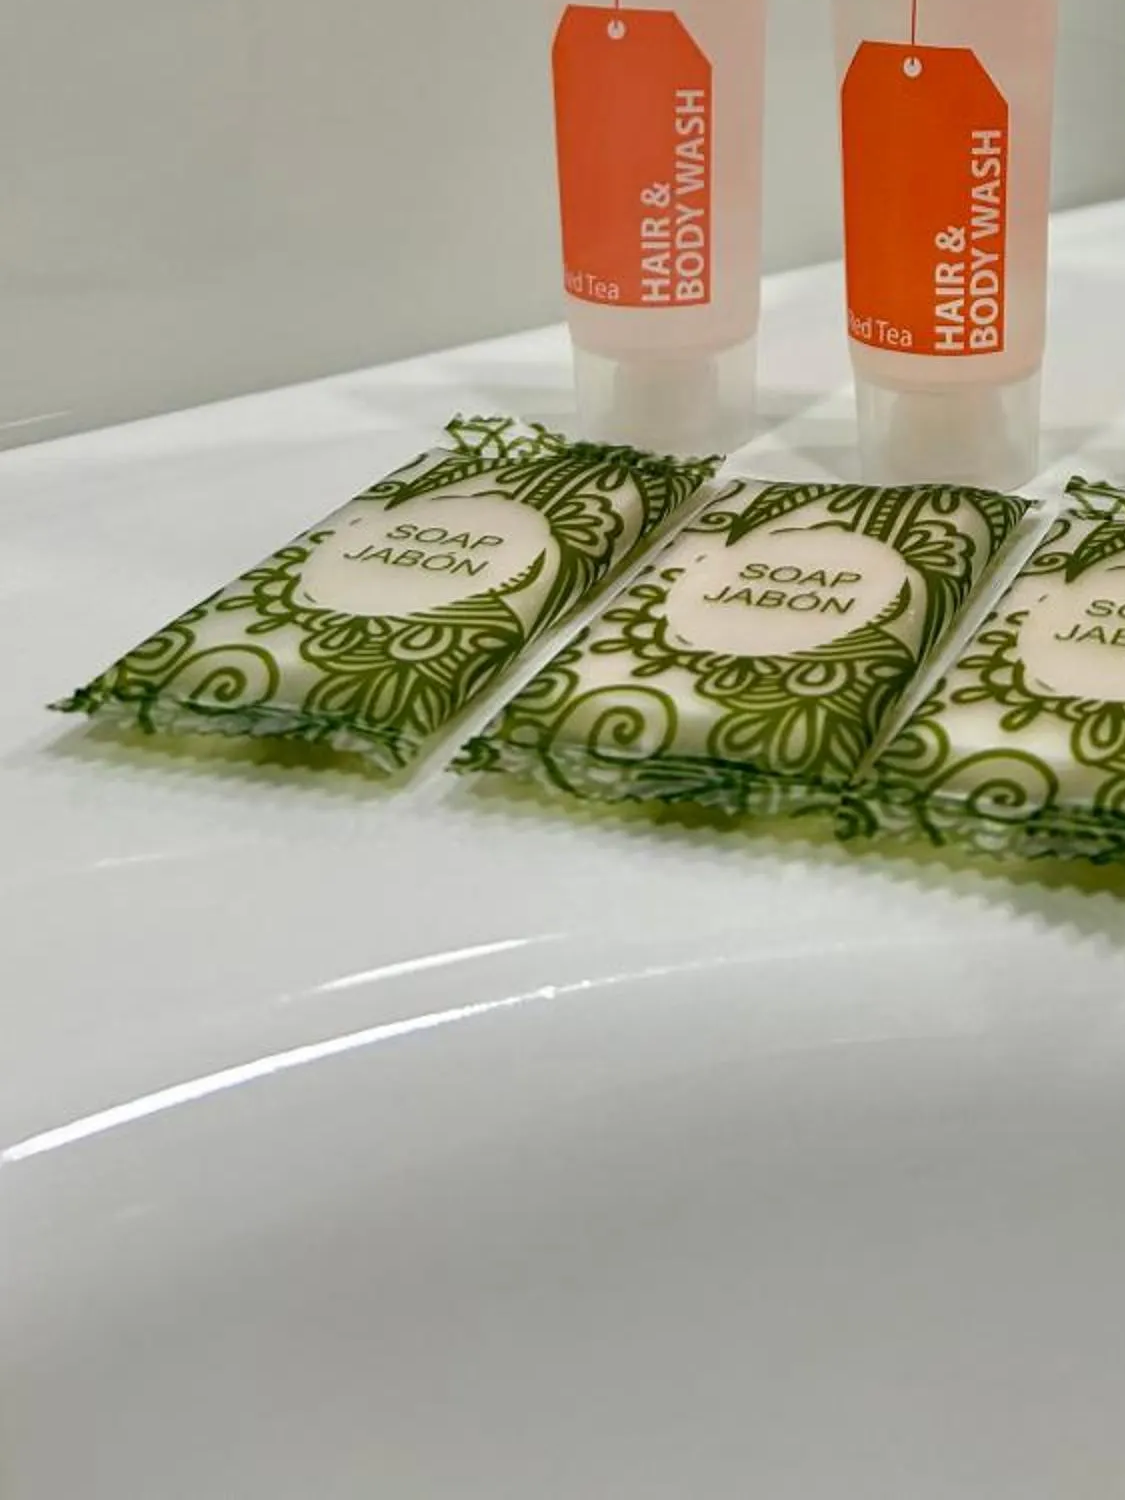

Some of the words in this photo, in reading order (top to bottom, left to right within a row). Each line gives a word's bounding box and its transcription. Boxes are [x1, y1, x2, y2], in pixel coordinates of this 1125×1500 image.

[675, 89, 705, 195] WASH
[640, 181, 671, 208] &
[971, 129, 1001, 240] WASH
[675, 203, 704, 300] BODY
[935, 225, 966, 253] &
[641, 217, 671, 302] HAIR
[587, 275, 620, 300] Tea
[969, 247, 999, 349] BODY
[934, 262, 965, 350] HAIR
[876, 320, 913, 347] Tea
[386, 523, 504, 550] SOAP
[343, 545, 489, 577] JABÓN
[739, 563, 862, 588] SOAP
[703, 586, 855, 615] JABÓN
